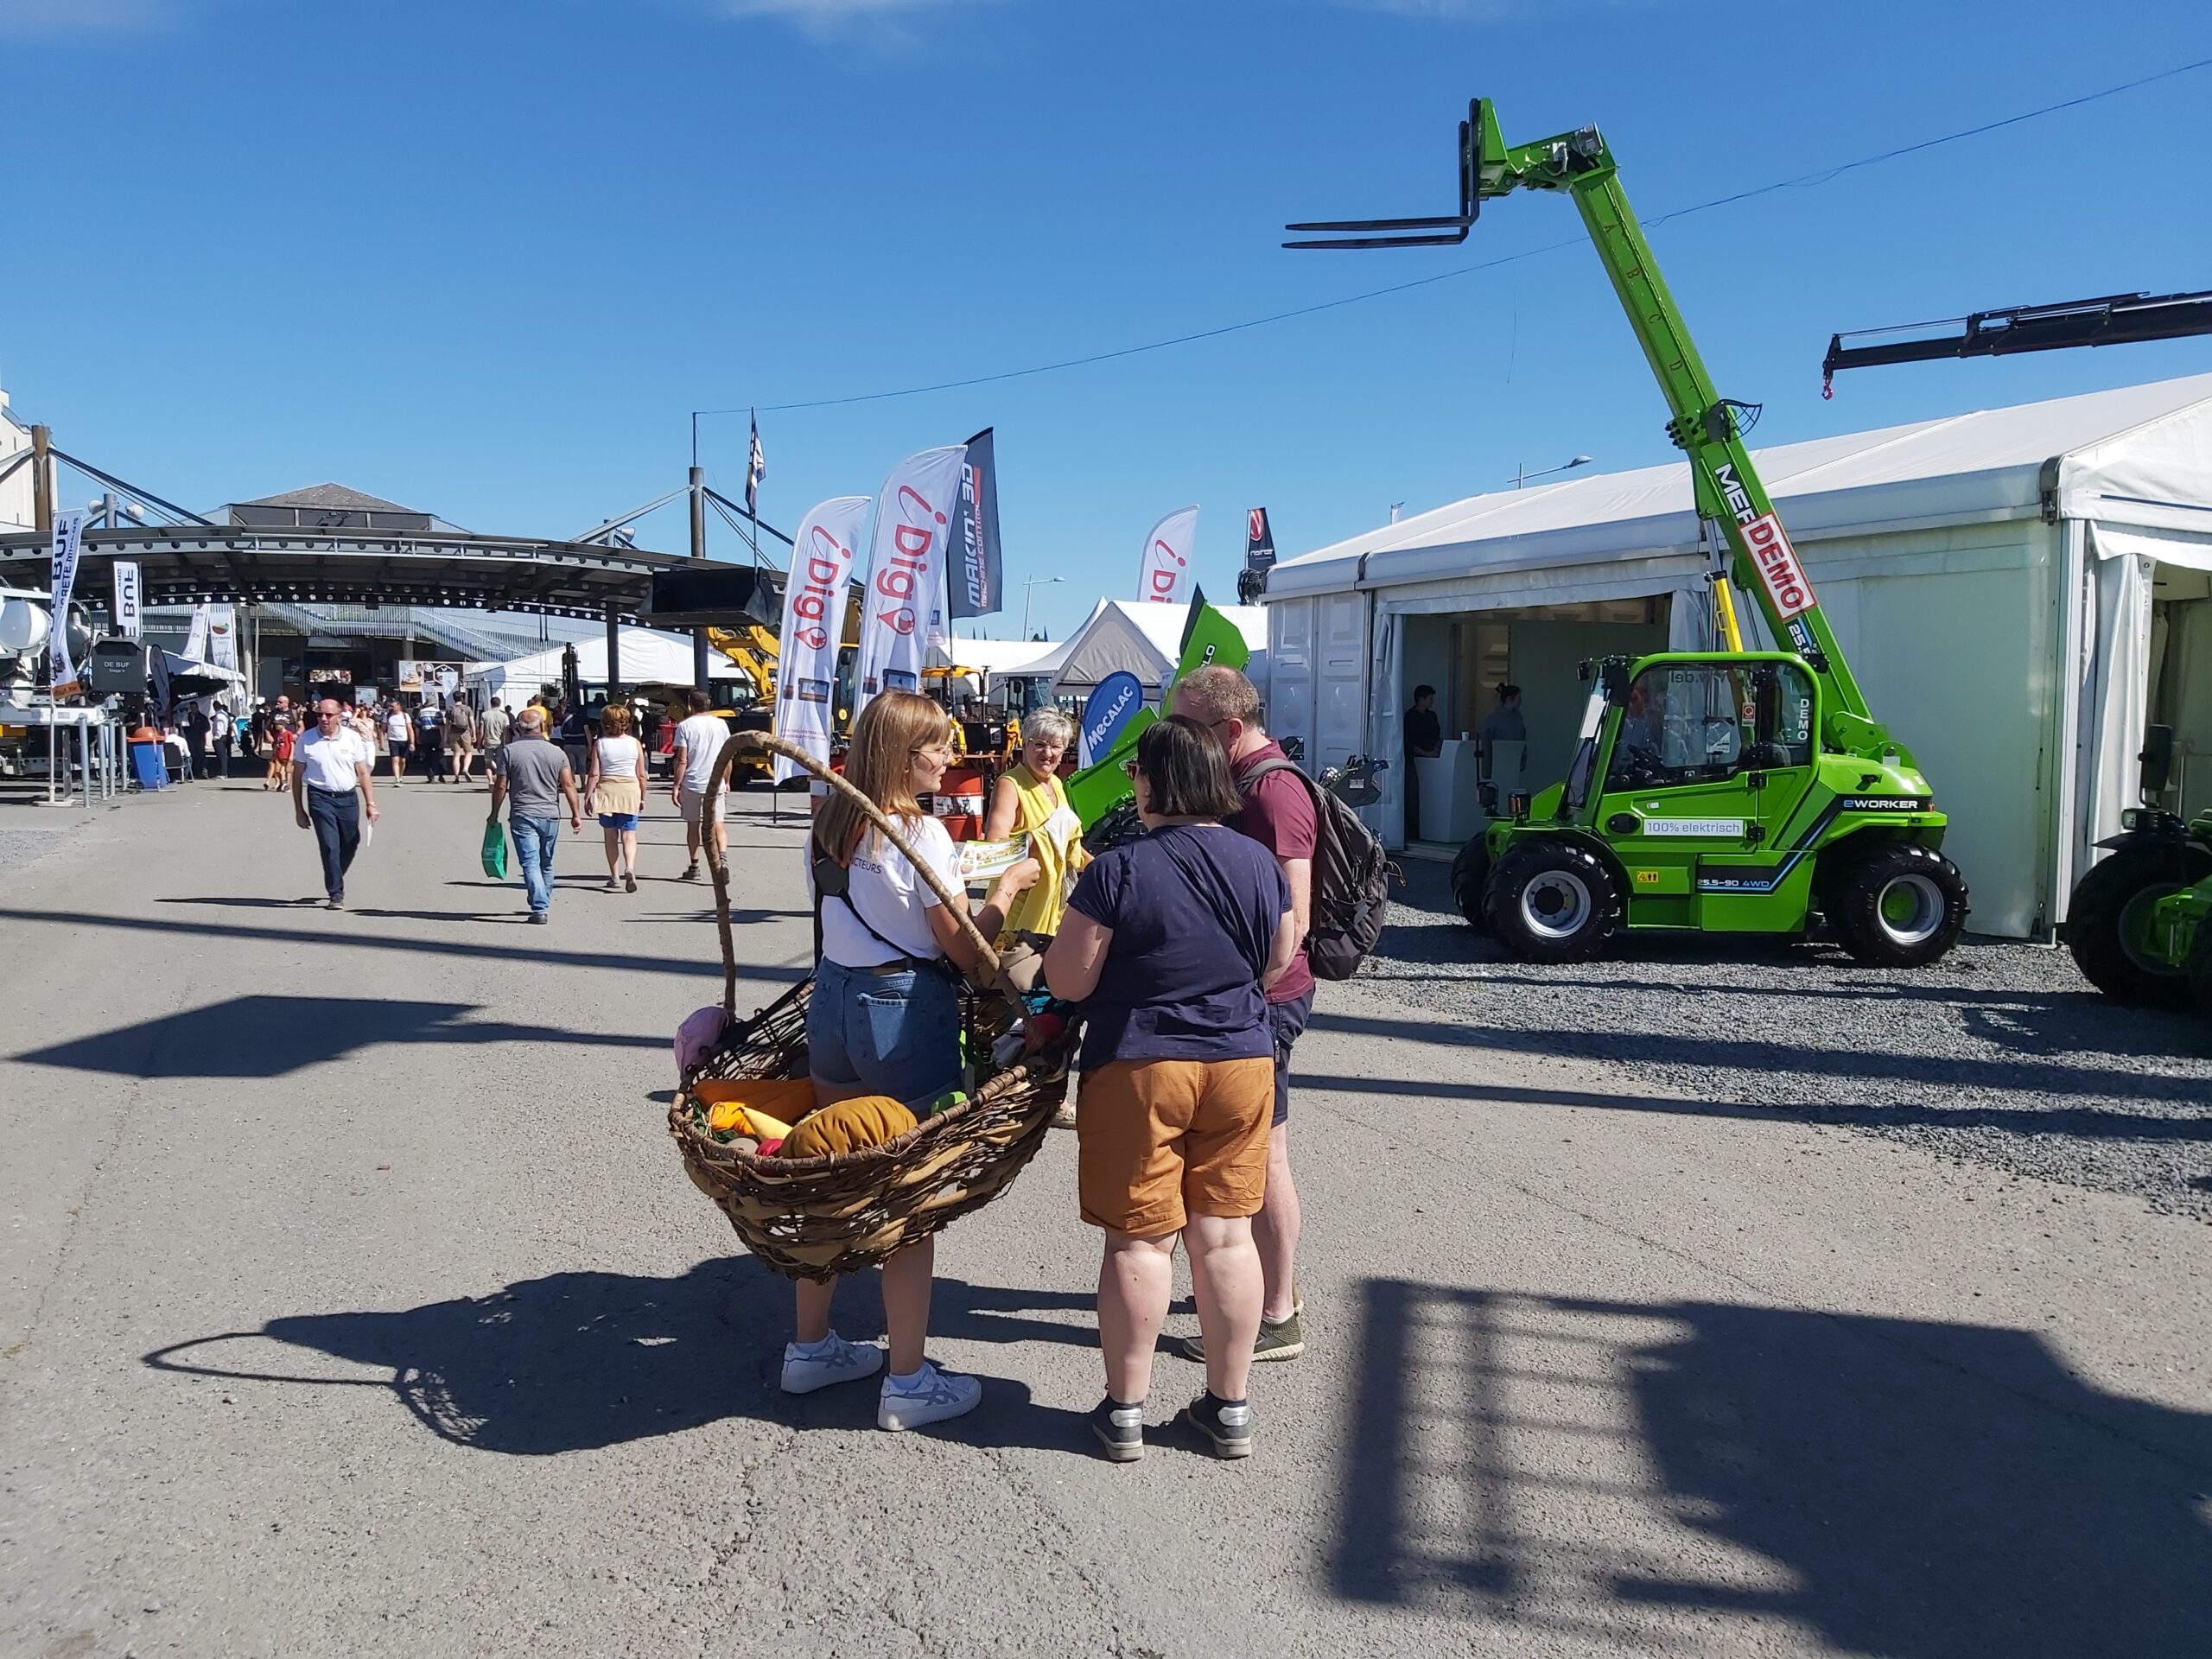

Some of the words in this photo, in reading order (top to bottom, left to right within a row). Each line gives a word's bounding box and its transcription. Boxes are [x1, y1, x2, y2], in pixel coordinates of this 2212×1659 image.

[1626, 268, 1640, 279] B
[1649, 314, 1661, 324] C
[1669, 359, 1682, 372] D
[52, 519, 69, 580] BUF
[1748, 522, 1804, 608] DEMO
[1200, 645, 1215, 667] LO
[1797, 698, 1809, 741] DEMO
[1843, 800, 1917, 809] eWORKER
[1648, 823, 1679, 832] 100%
[1682, 823, 1739, 833] elektrisch
[852, 857, 882, 874] CTEURS
